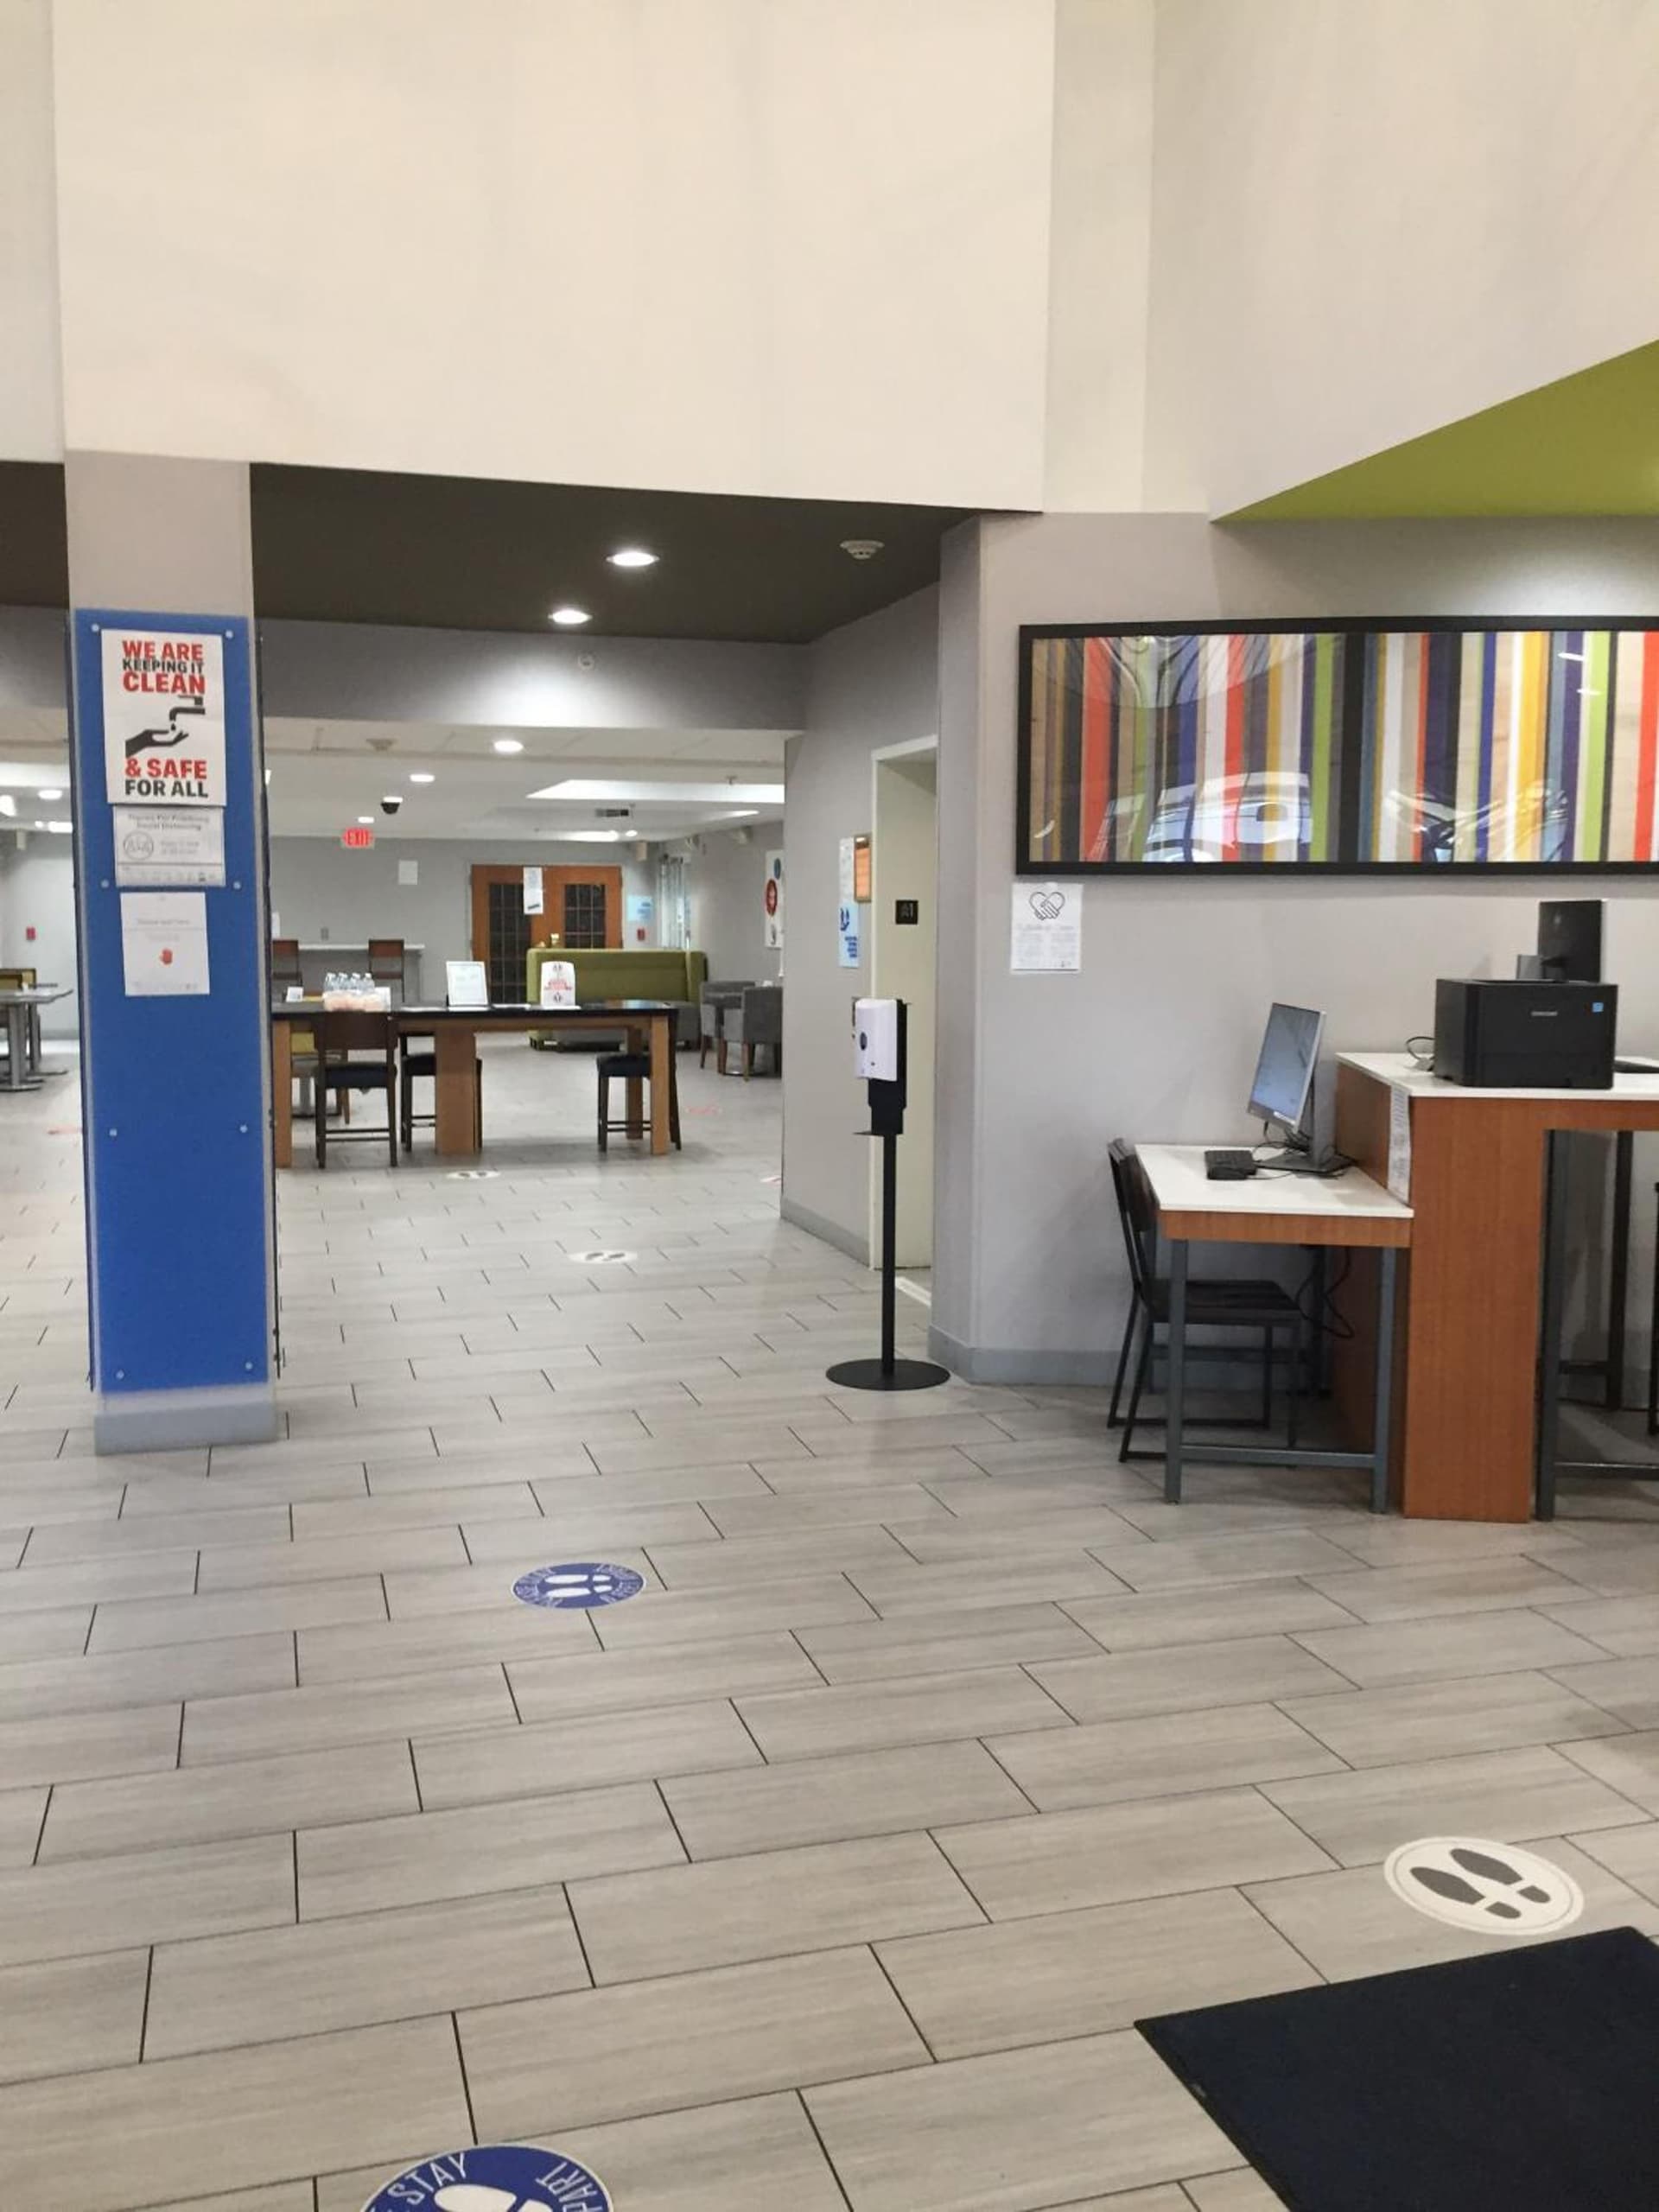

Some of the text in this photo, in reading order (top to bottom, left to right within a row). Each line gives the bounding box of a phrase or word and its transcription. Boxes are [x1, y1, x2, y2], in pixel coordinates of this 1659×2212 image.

[122, 640, 204, 662] WE ARE
[122, 658, 204, 675] KEEPING IT
[123, 671, 206, 695] CLEAN
[125, 758, 207, 779] & SAFE
[124, 779, 209, 798] FOR ALL
[346, 829, 372, 846] EXIT
[386, 2152, 467, 2206] STAY
[535, 2161, 603, 2212] PART
